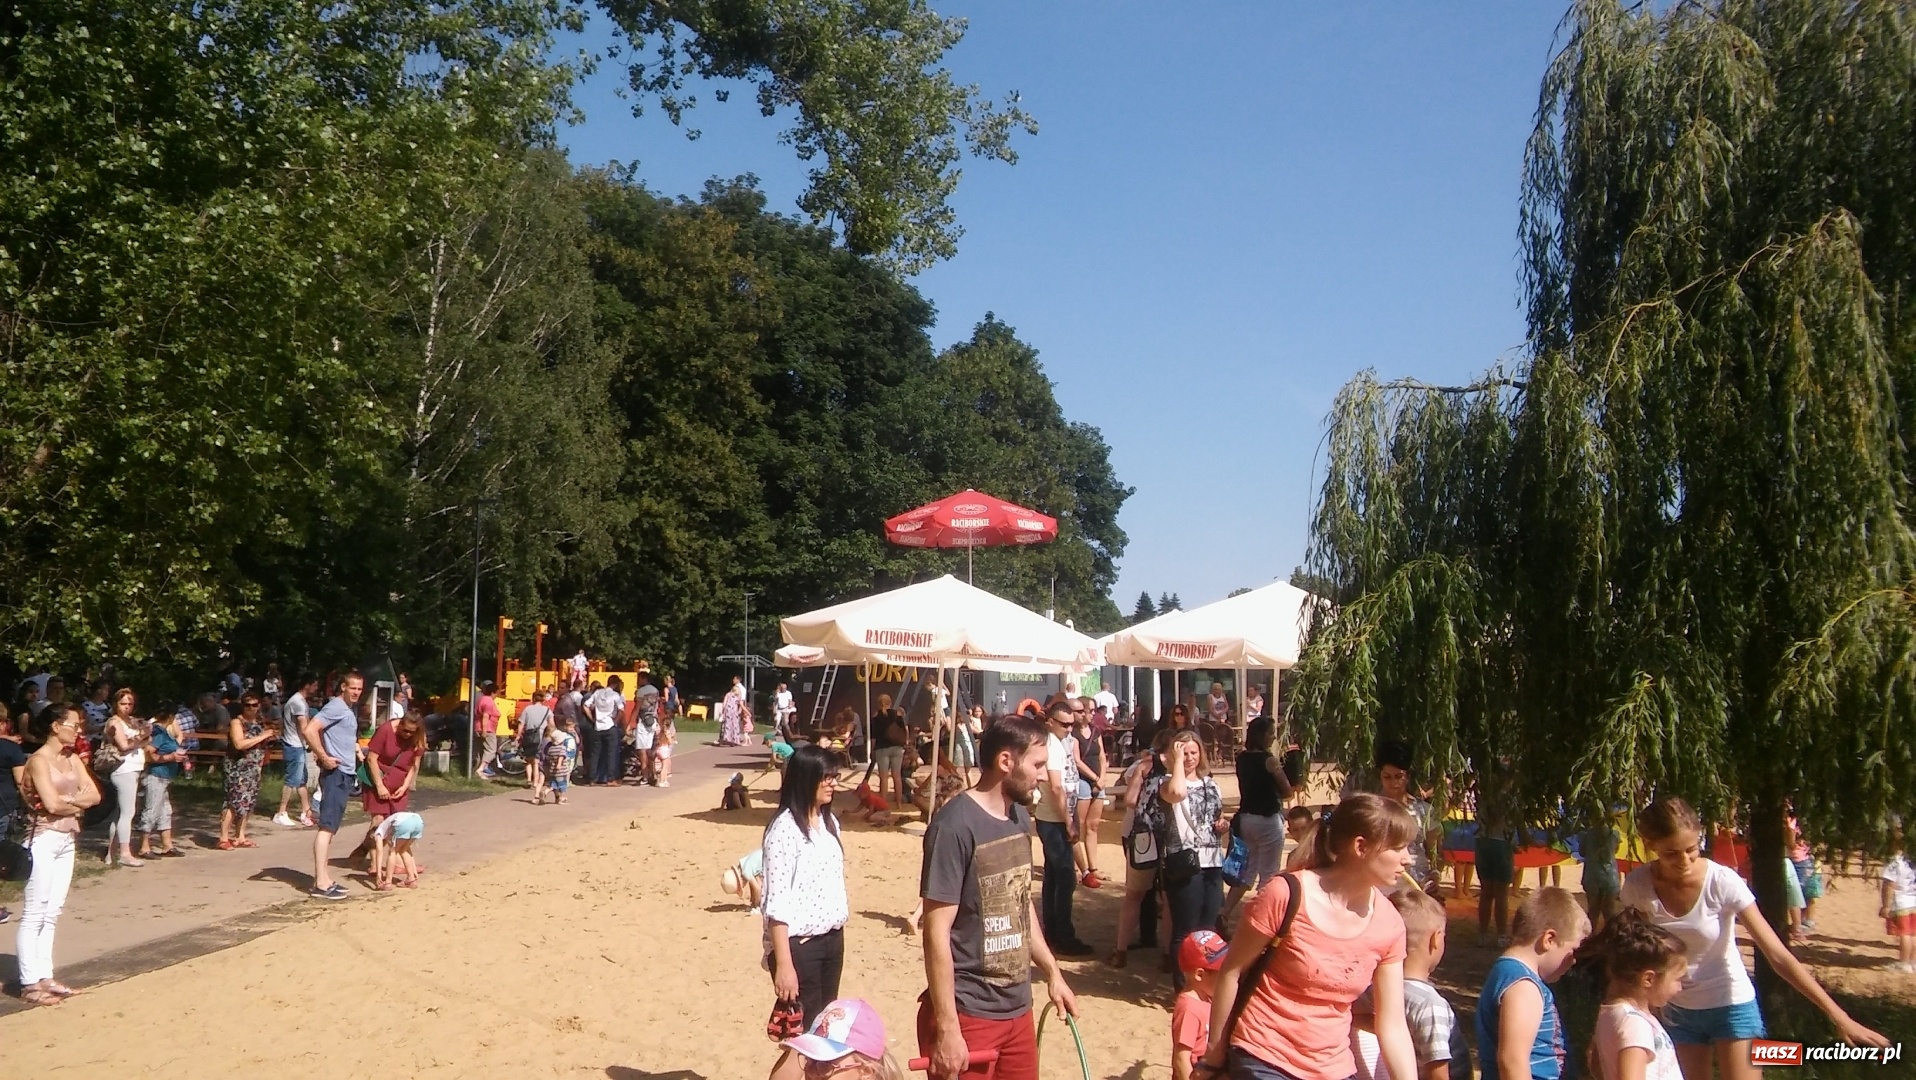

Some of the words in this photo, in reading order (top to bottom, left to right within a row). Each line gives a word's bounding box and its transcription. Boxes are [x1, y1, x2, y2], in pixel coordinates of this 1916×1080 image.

[951, 518, 990, 528] RACIBORSKIE
[865, 629, 933, 648] RACIBORSKIE
[1155, 642, 1218, 659] RACIBORSKIE
[856, 662, 918, 682] ODRA
[984, 915, 1012, 933] SPECIAL
